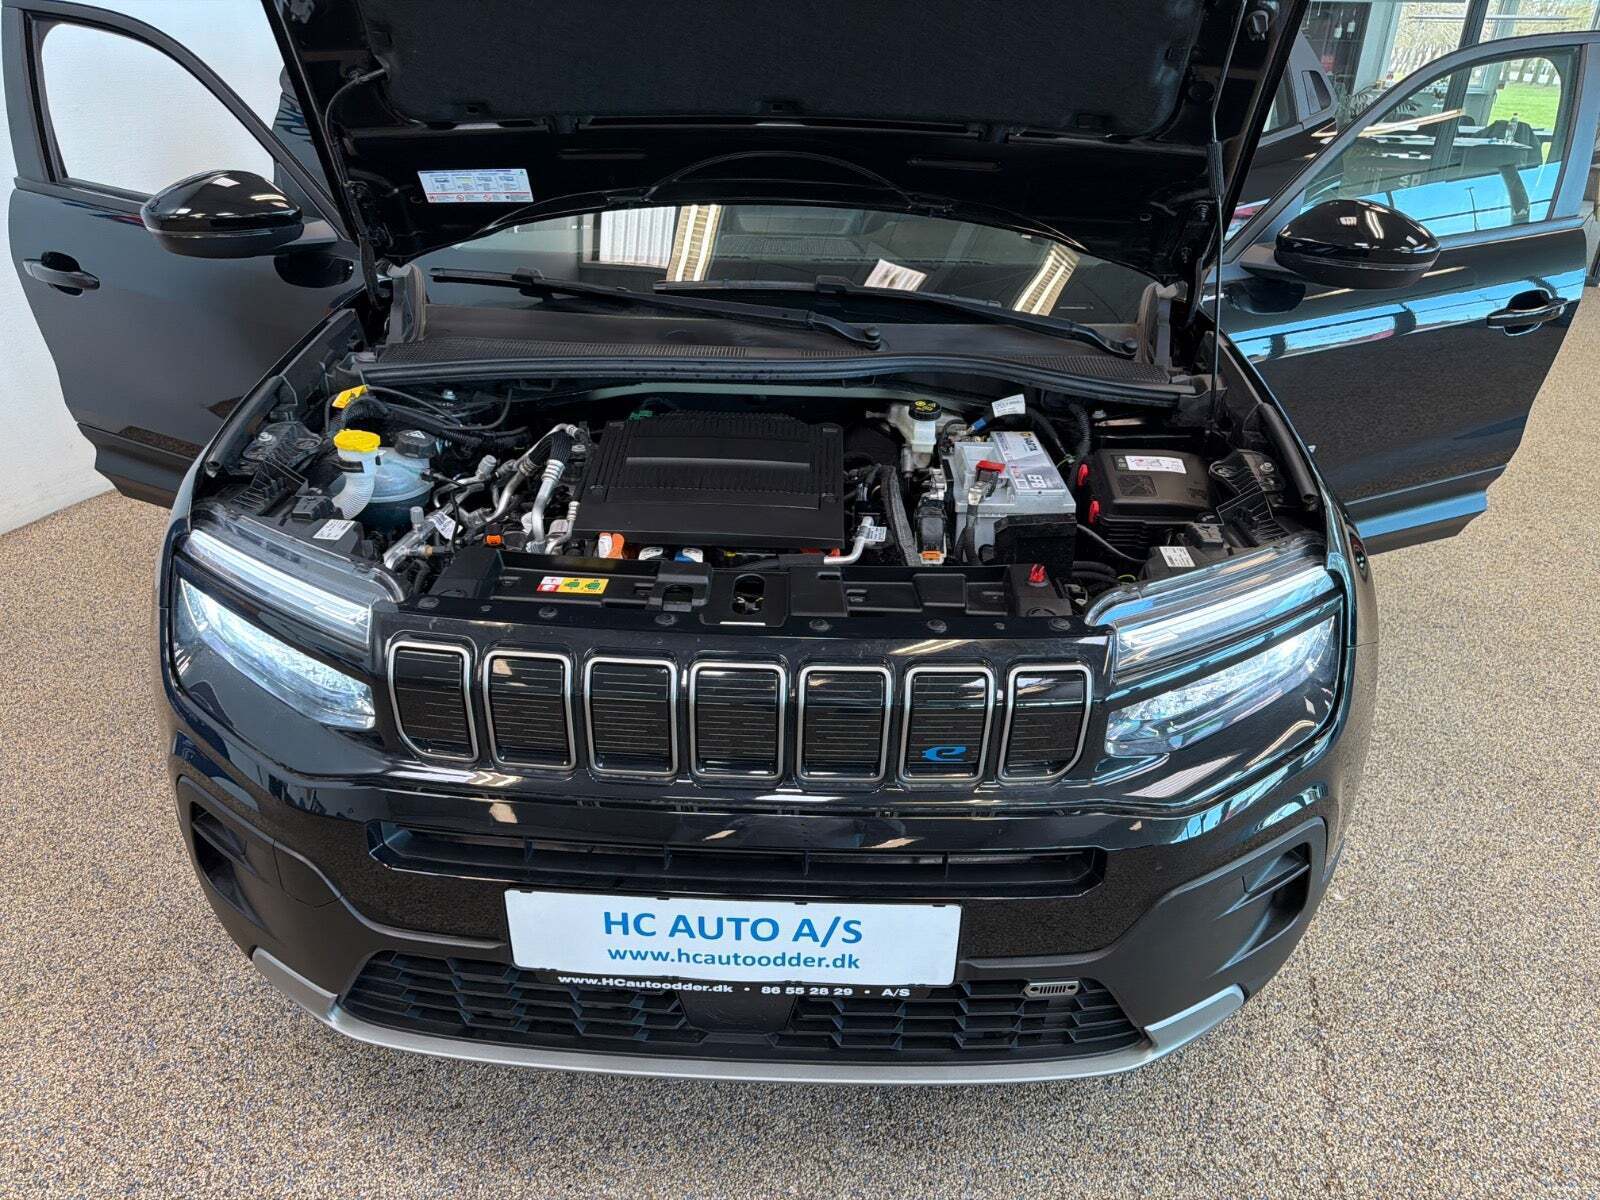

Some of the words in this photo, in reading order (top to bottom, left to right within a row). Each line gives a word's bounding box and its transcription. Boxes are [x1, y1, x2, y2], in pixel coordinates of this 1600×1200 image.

[603, 911, 657, 937] HC
[668, 914, 780, 942] AUTO
[791, 916, 863, 948] A/S
[607, 947, 860, 969] www.hcautoodder.dk
[557, 975, 733, 993] www.HCautoodder.dk
[761, 986, 781, 995] 86
[785, 986, 805, 995] 55
[809, 987, 829, 996] 28
[833, 987, 853, 996] 29
[881, 988, 911, 998] A/S
